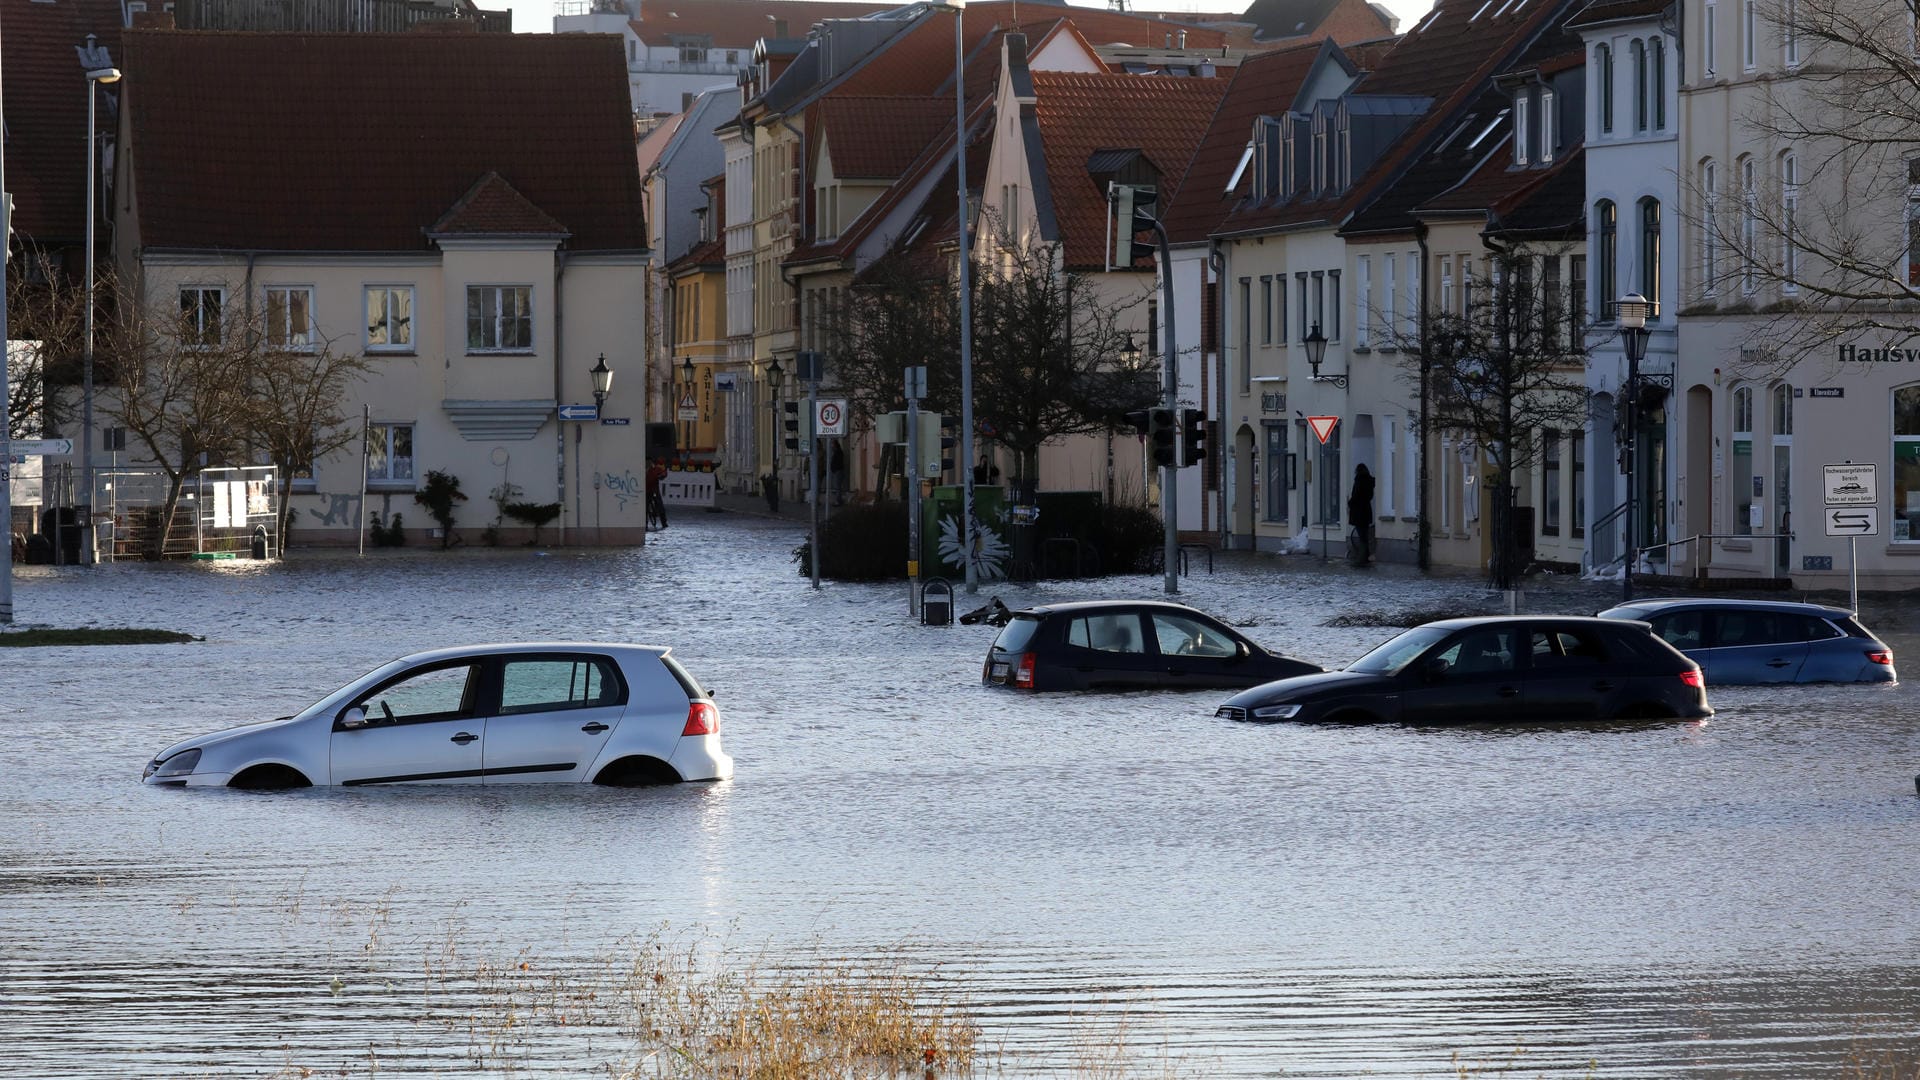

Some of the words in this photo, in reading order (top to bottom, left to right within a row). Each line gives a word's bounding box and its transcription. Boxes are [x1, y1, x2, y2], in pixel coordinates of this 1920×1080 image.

[1838, 344, 1920, 362] Hausv
[824, 409, 836, 420] 30
[1825, 467, 1873, 475] Hochwassergefährdeter
